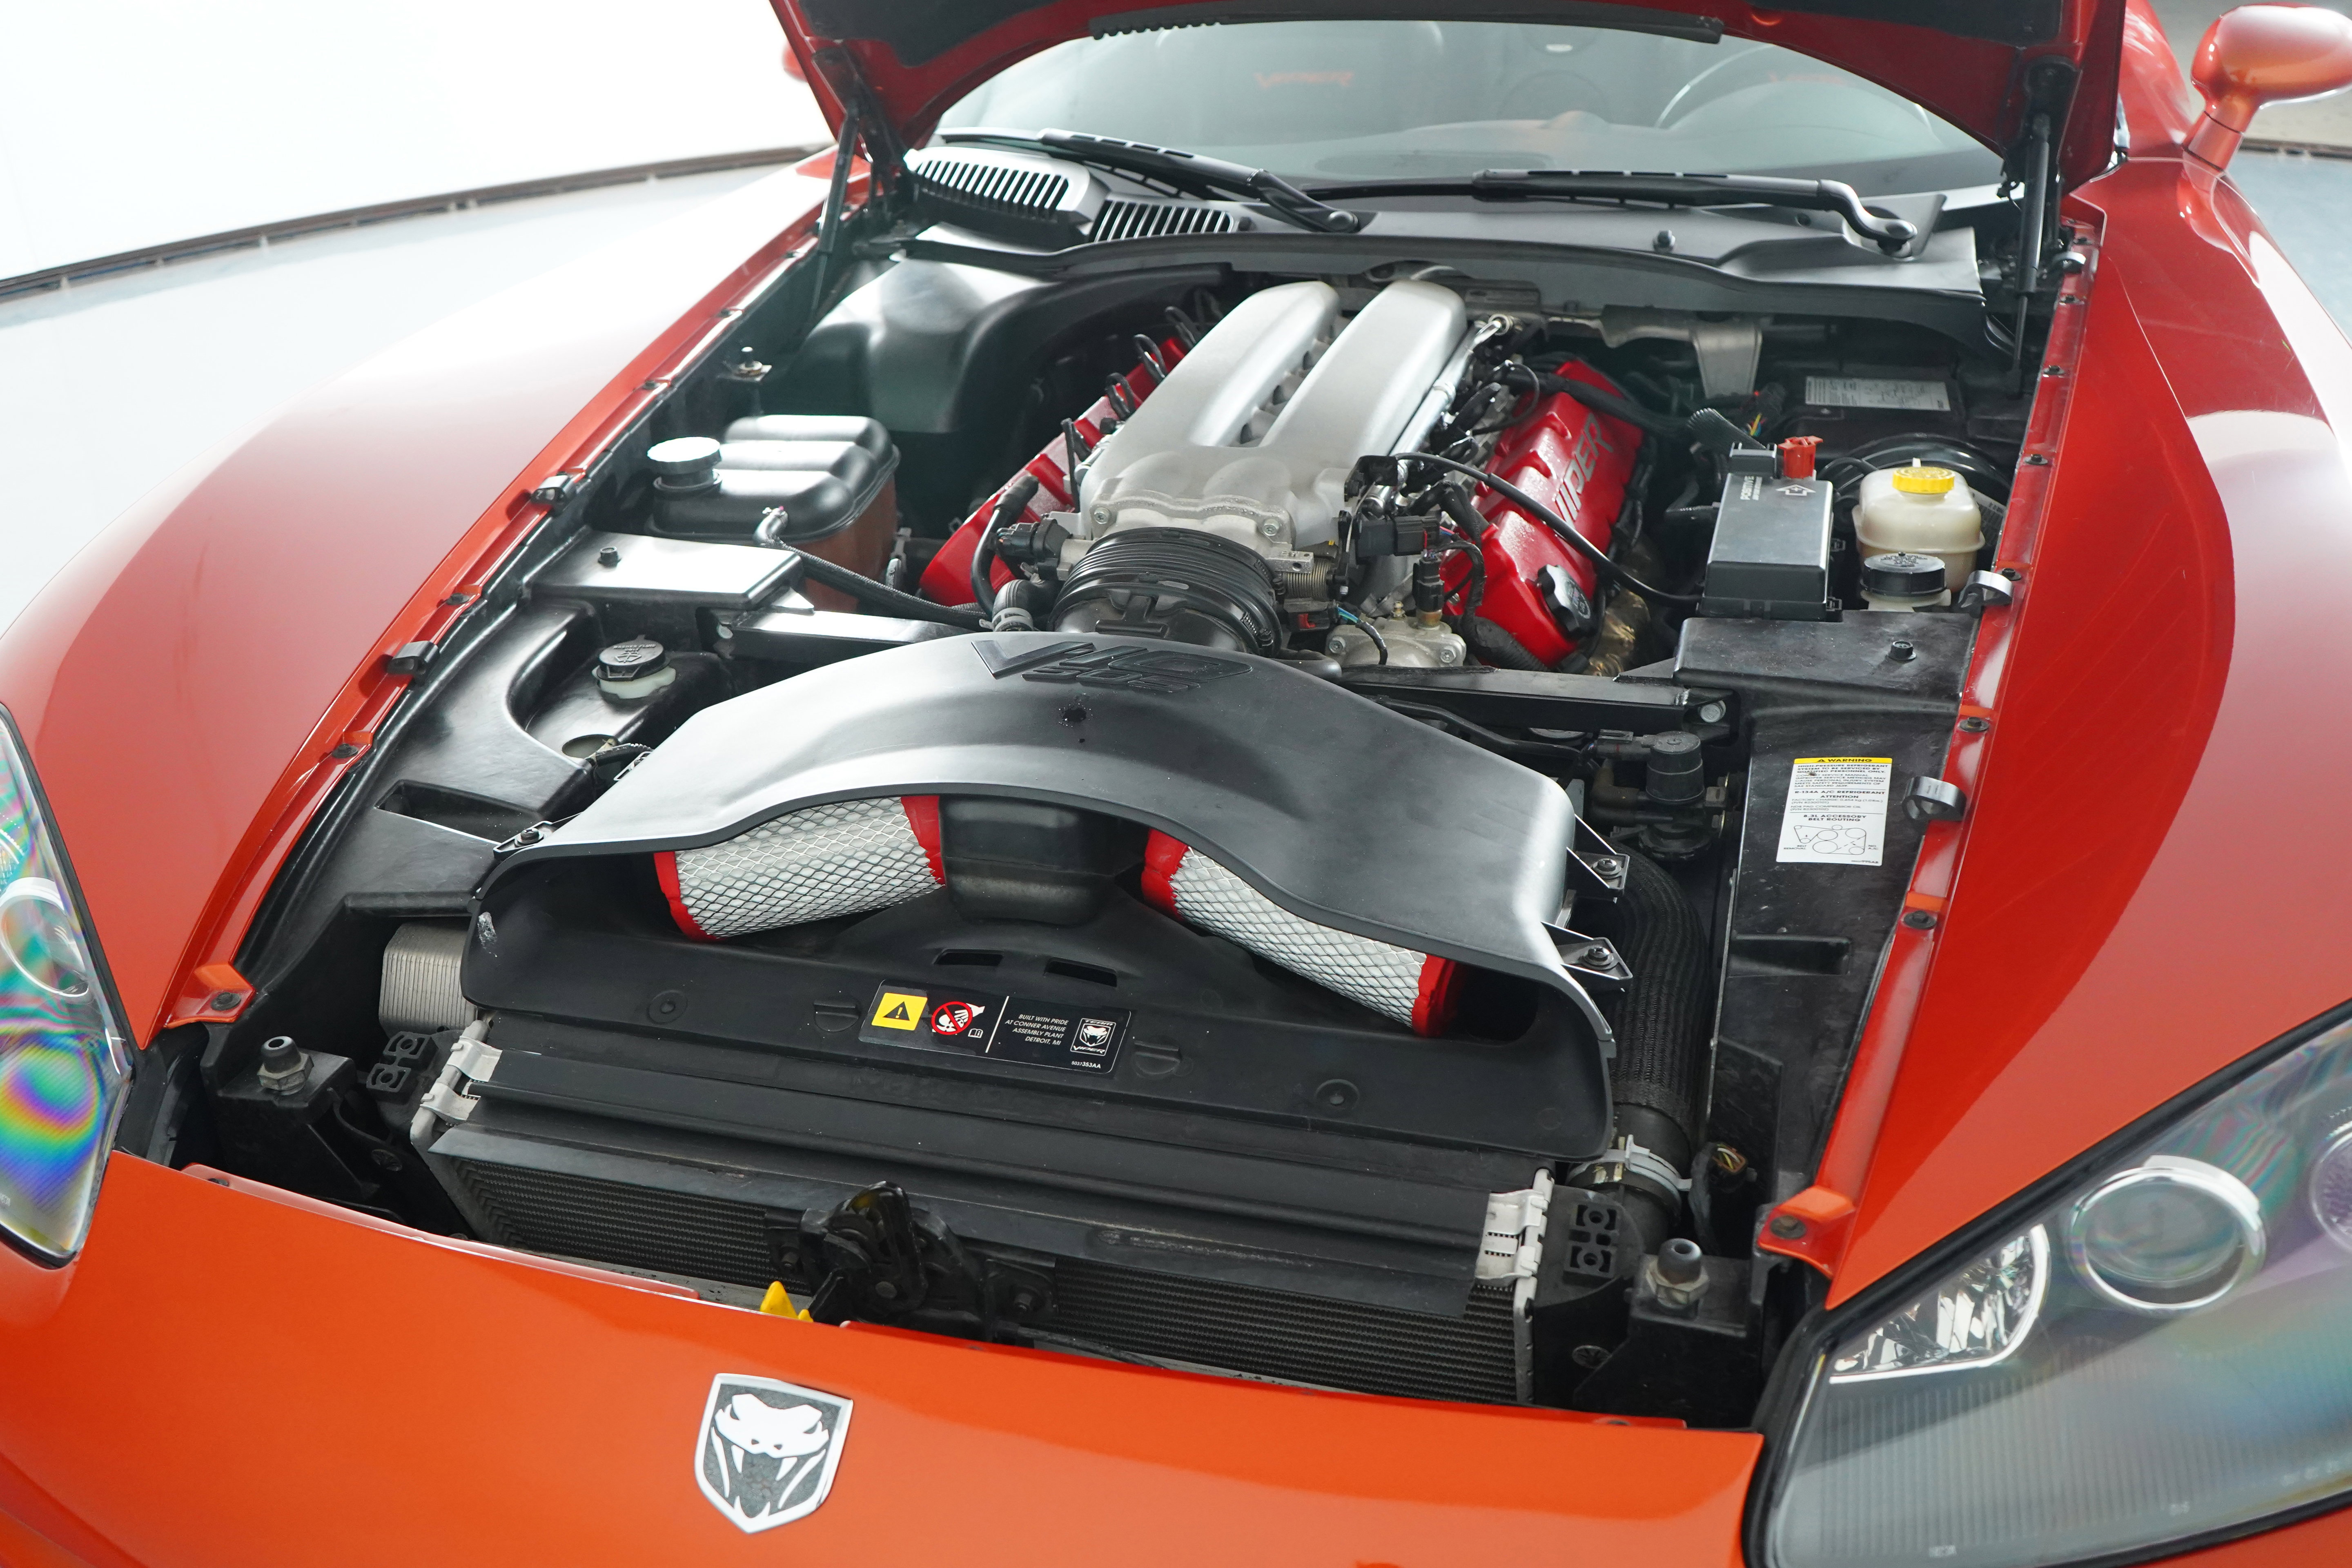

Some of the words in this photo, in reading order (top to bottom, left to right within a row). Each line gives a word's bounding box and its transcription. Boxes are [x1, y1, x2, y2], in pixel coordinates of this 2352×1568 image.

[1014, 1020, 1041, 1029] CONNER
[1012, 1027, 1043, 1036] ASSEMBLY
[1025, 1036, 1051, 1045] DETROIT,
[1073, 1045, 1105, 1054] VIPER
